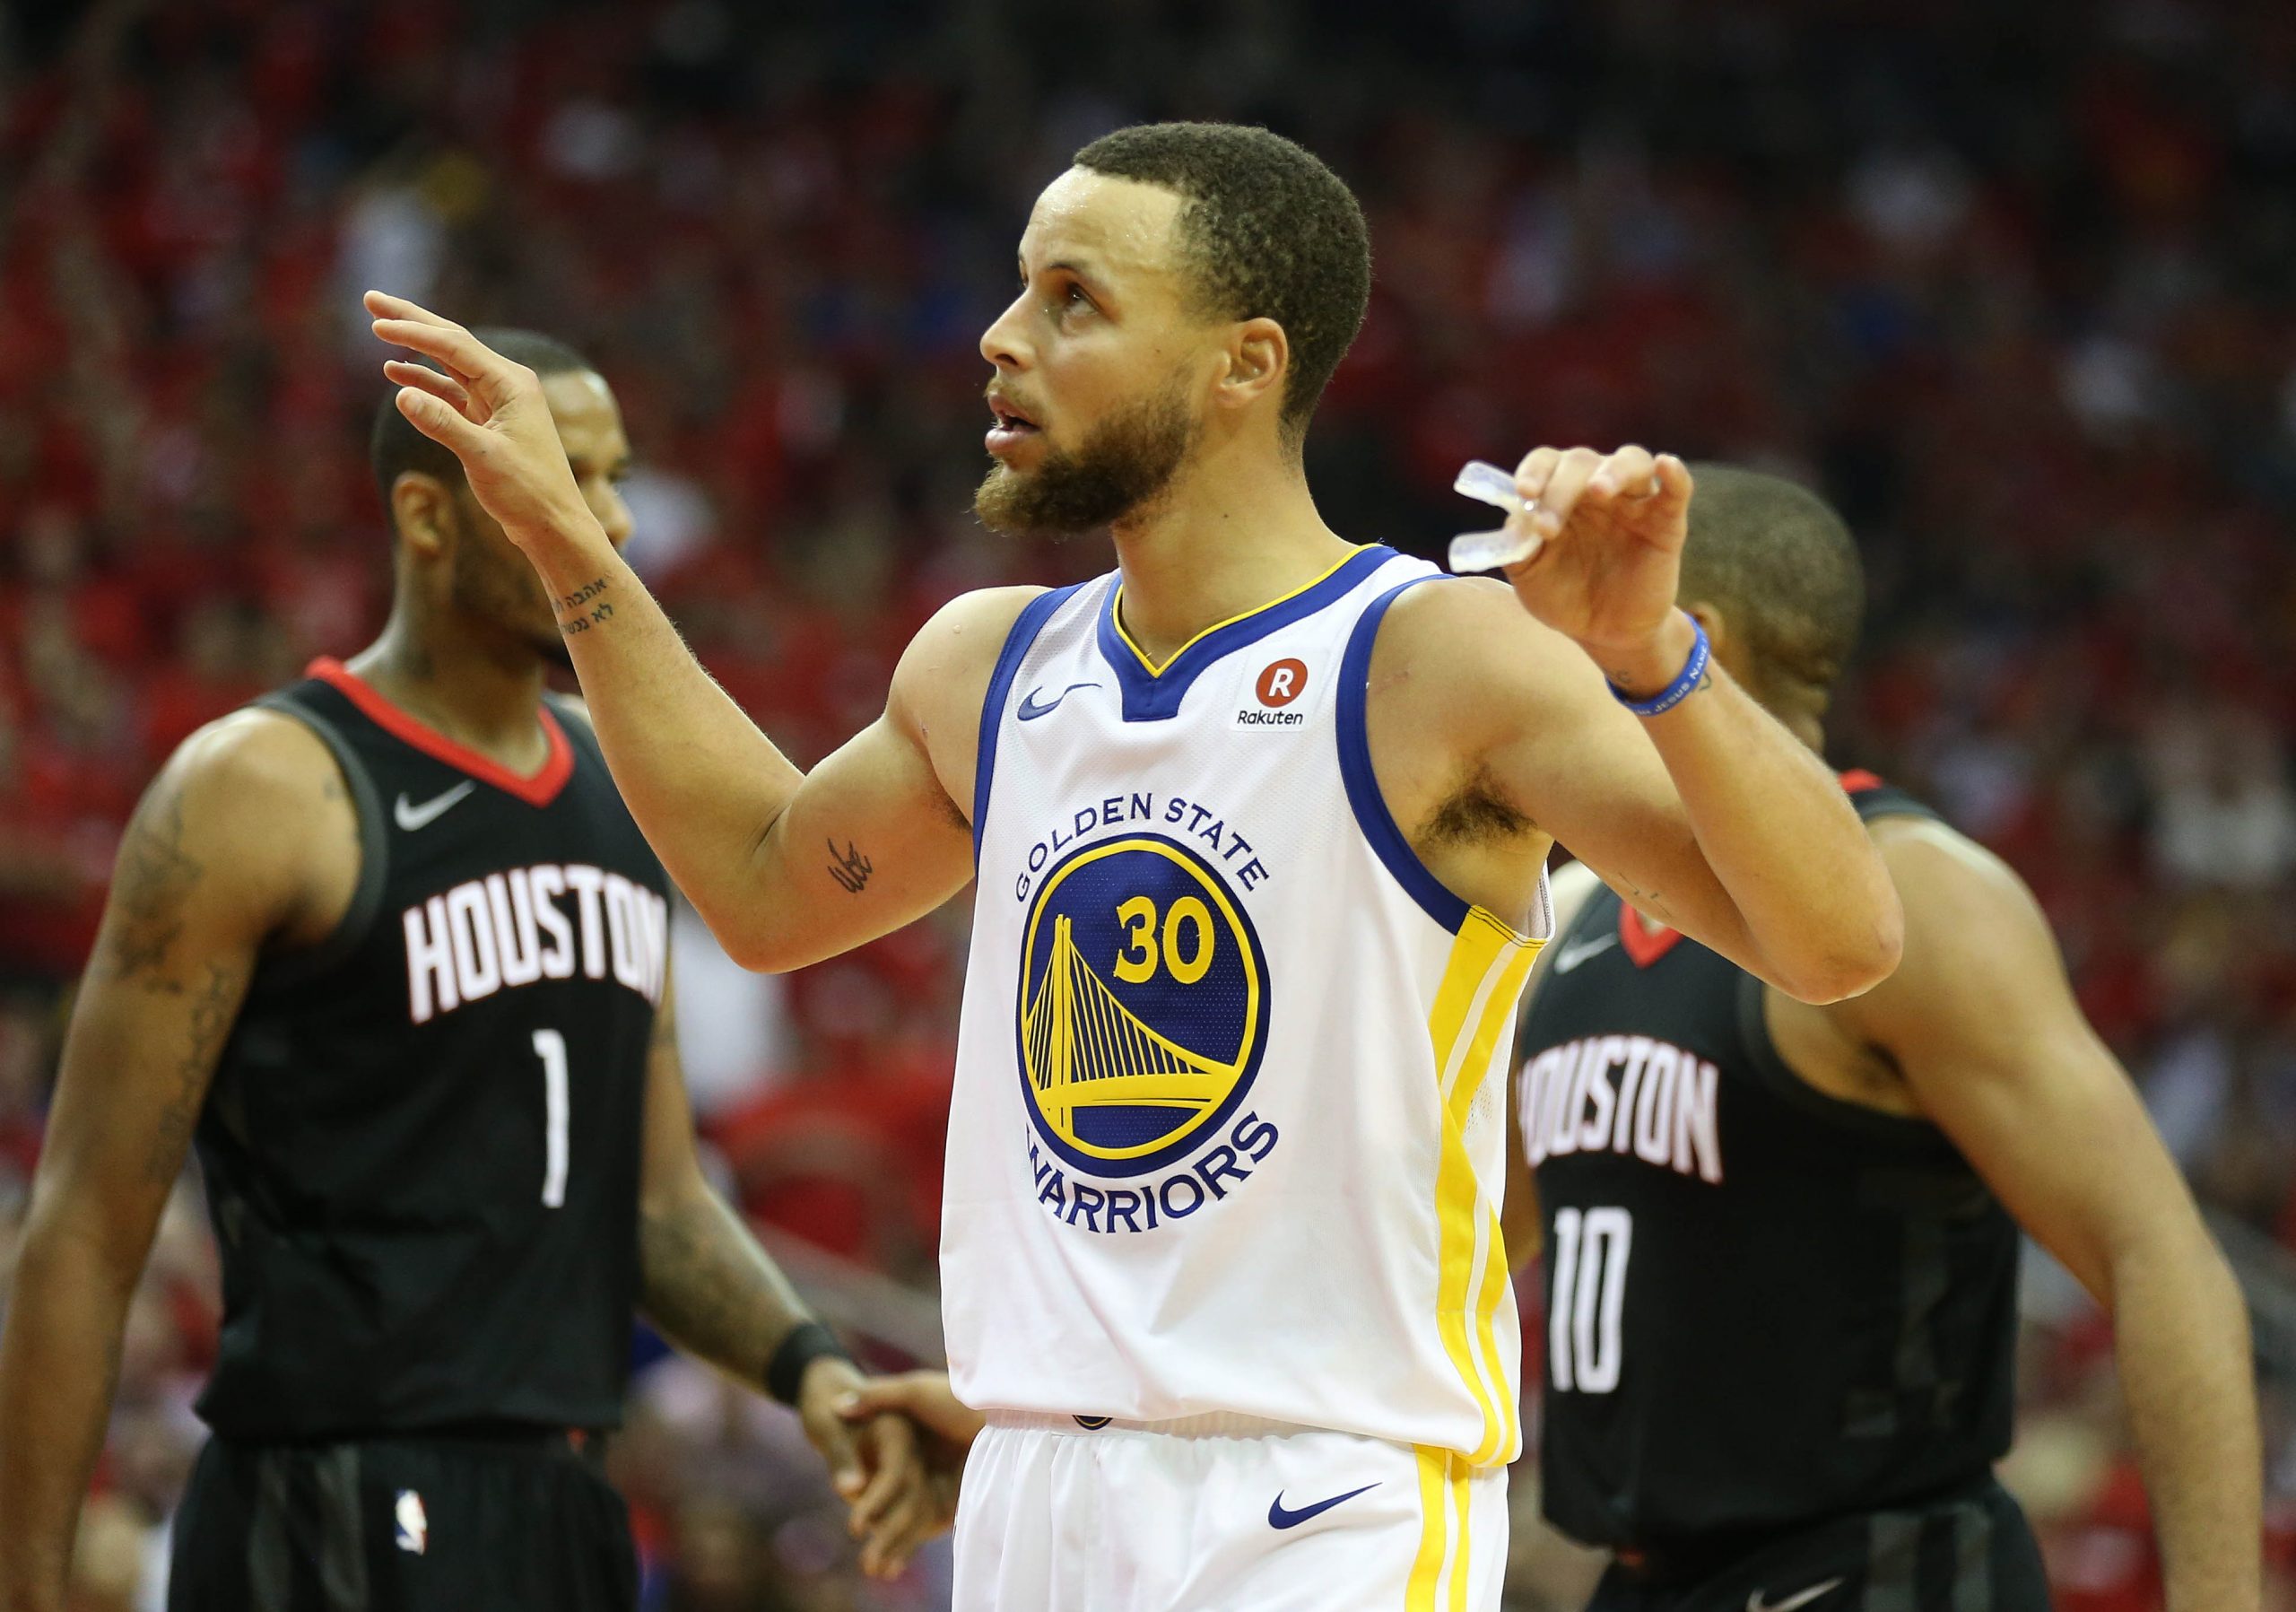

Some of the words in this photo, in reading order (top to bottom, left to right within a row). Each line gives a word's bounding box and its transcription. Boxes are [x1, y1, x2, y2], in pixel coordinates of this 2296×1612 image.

[1237, 710, 1304, 725] Rakuten
[1268, 667, 1294, 697] R
[1015, 793, 1153, 902] GOLDEN
[1164, 797, 1270, 892] STATE
[403, 862, 668, 1025] HOUSTON
[1113, 895, 1215, 985] 30
[531, 1028, 570, 1209] 1
[1549, 1206, 1633, 1394] 10
